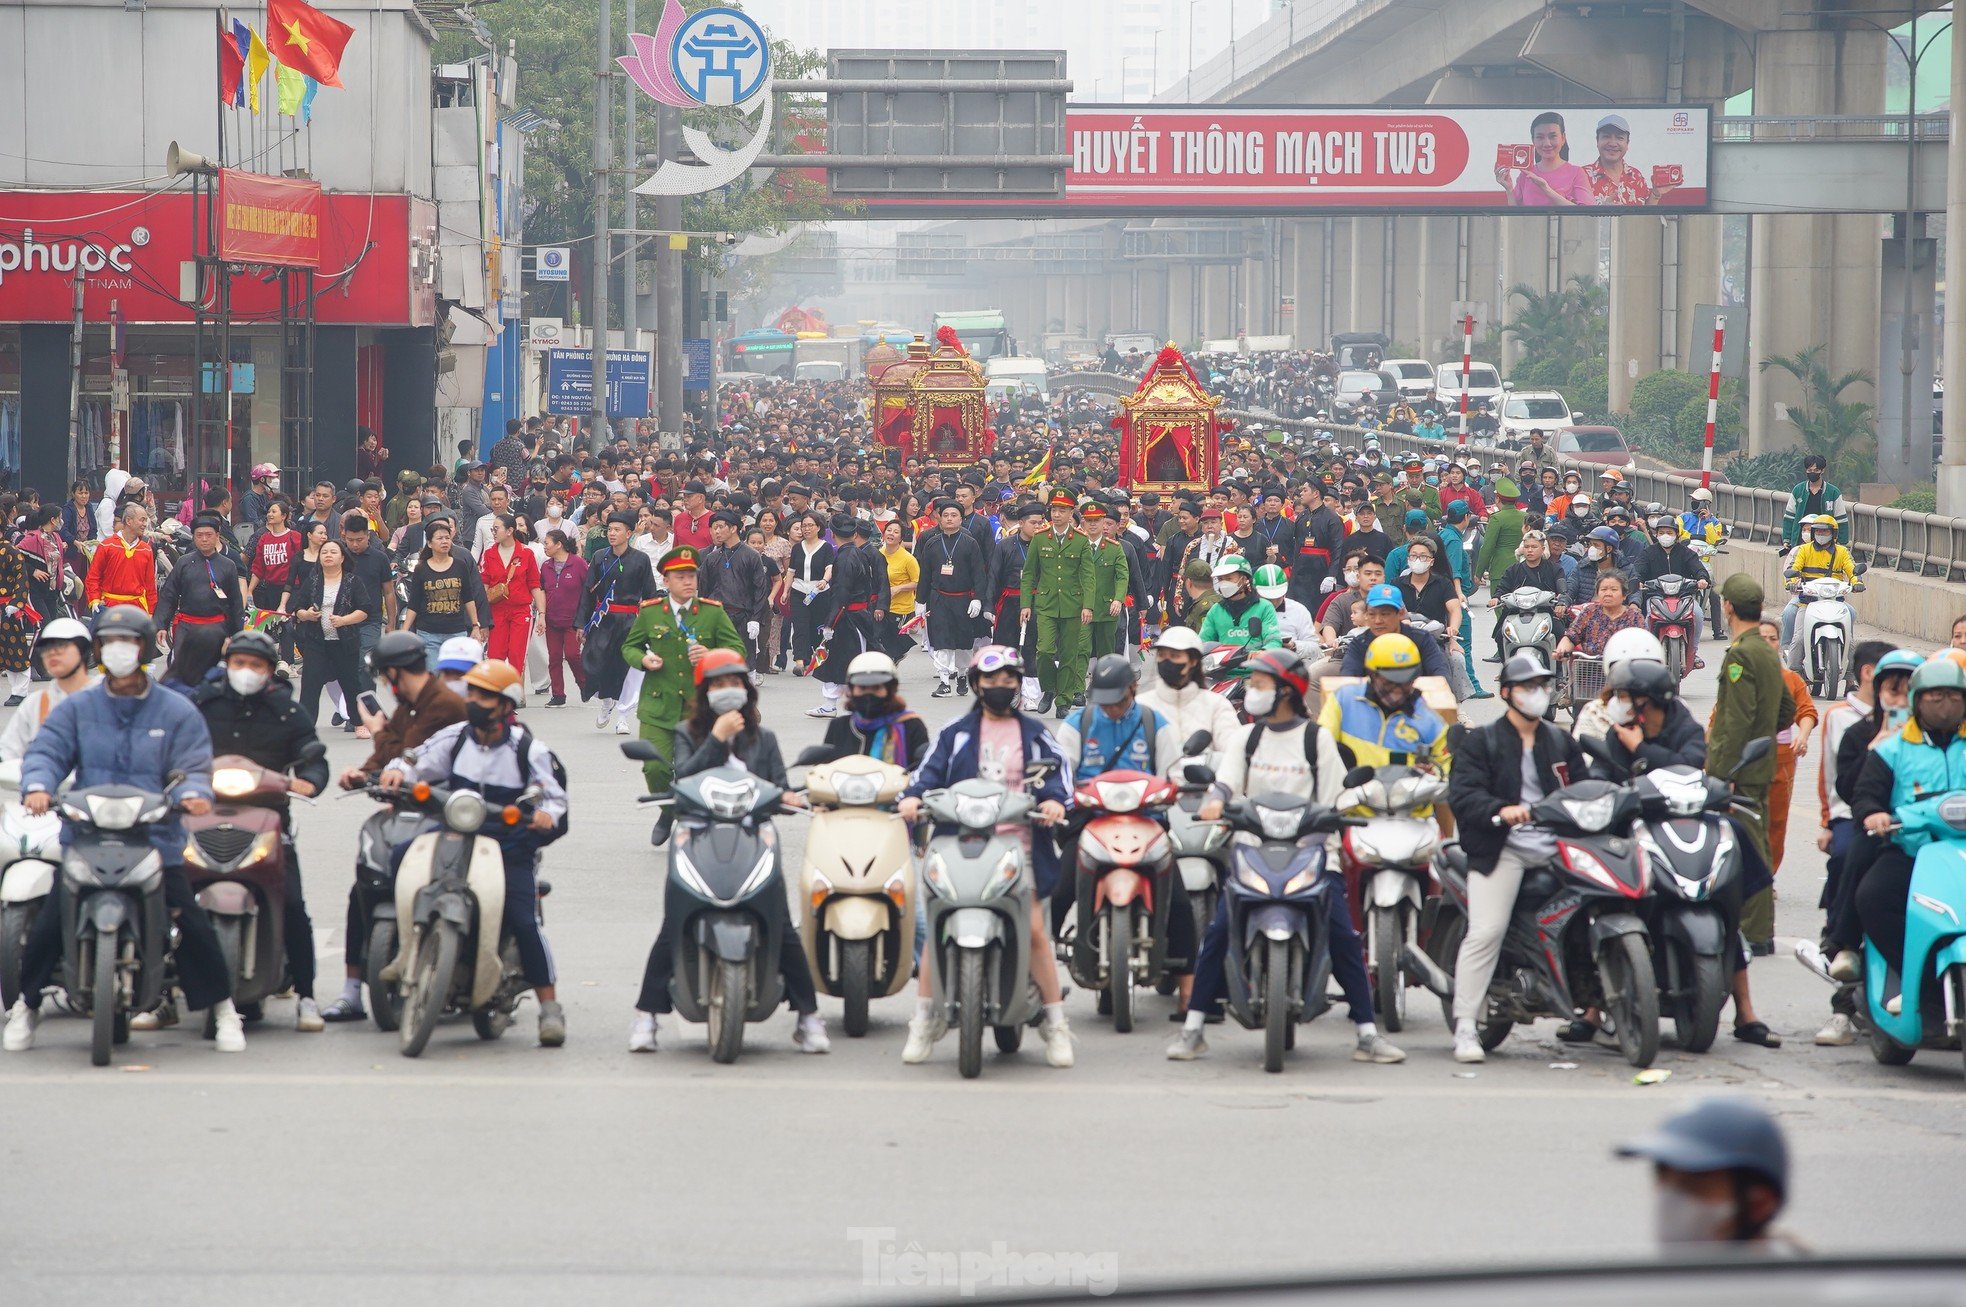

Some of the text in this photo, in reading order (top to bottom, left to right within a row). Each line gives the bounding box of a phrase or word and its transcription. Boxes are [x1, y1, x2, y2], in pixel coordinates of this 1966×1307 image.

[1073, 116, 1436, 184] HUYẾT THÔNG MẠCH TW3
[566, 351, 584, 360] PHÒNG
[623, 352, 630, 362] HÀ
[263, 542, 287, 555] HOLLY
[263, 553, 288, 565] CHIC
[427, 578, 460, 590] LOVE
[431, 601, 457, 612] YORK
[1227, 628, 1249, 637] Grab
